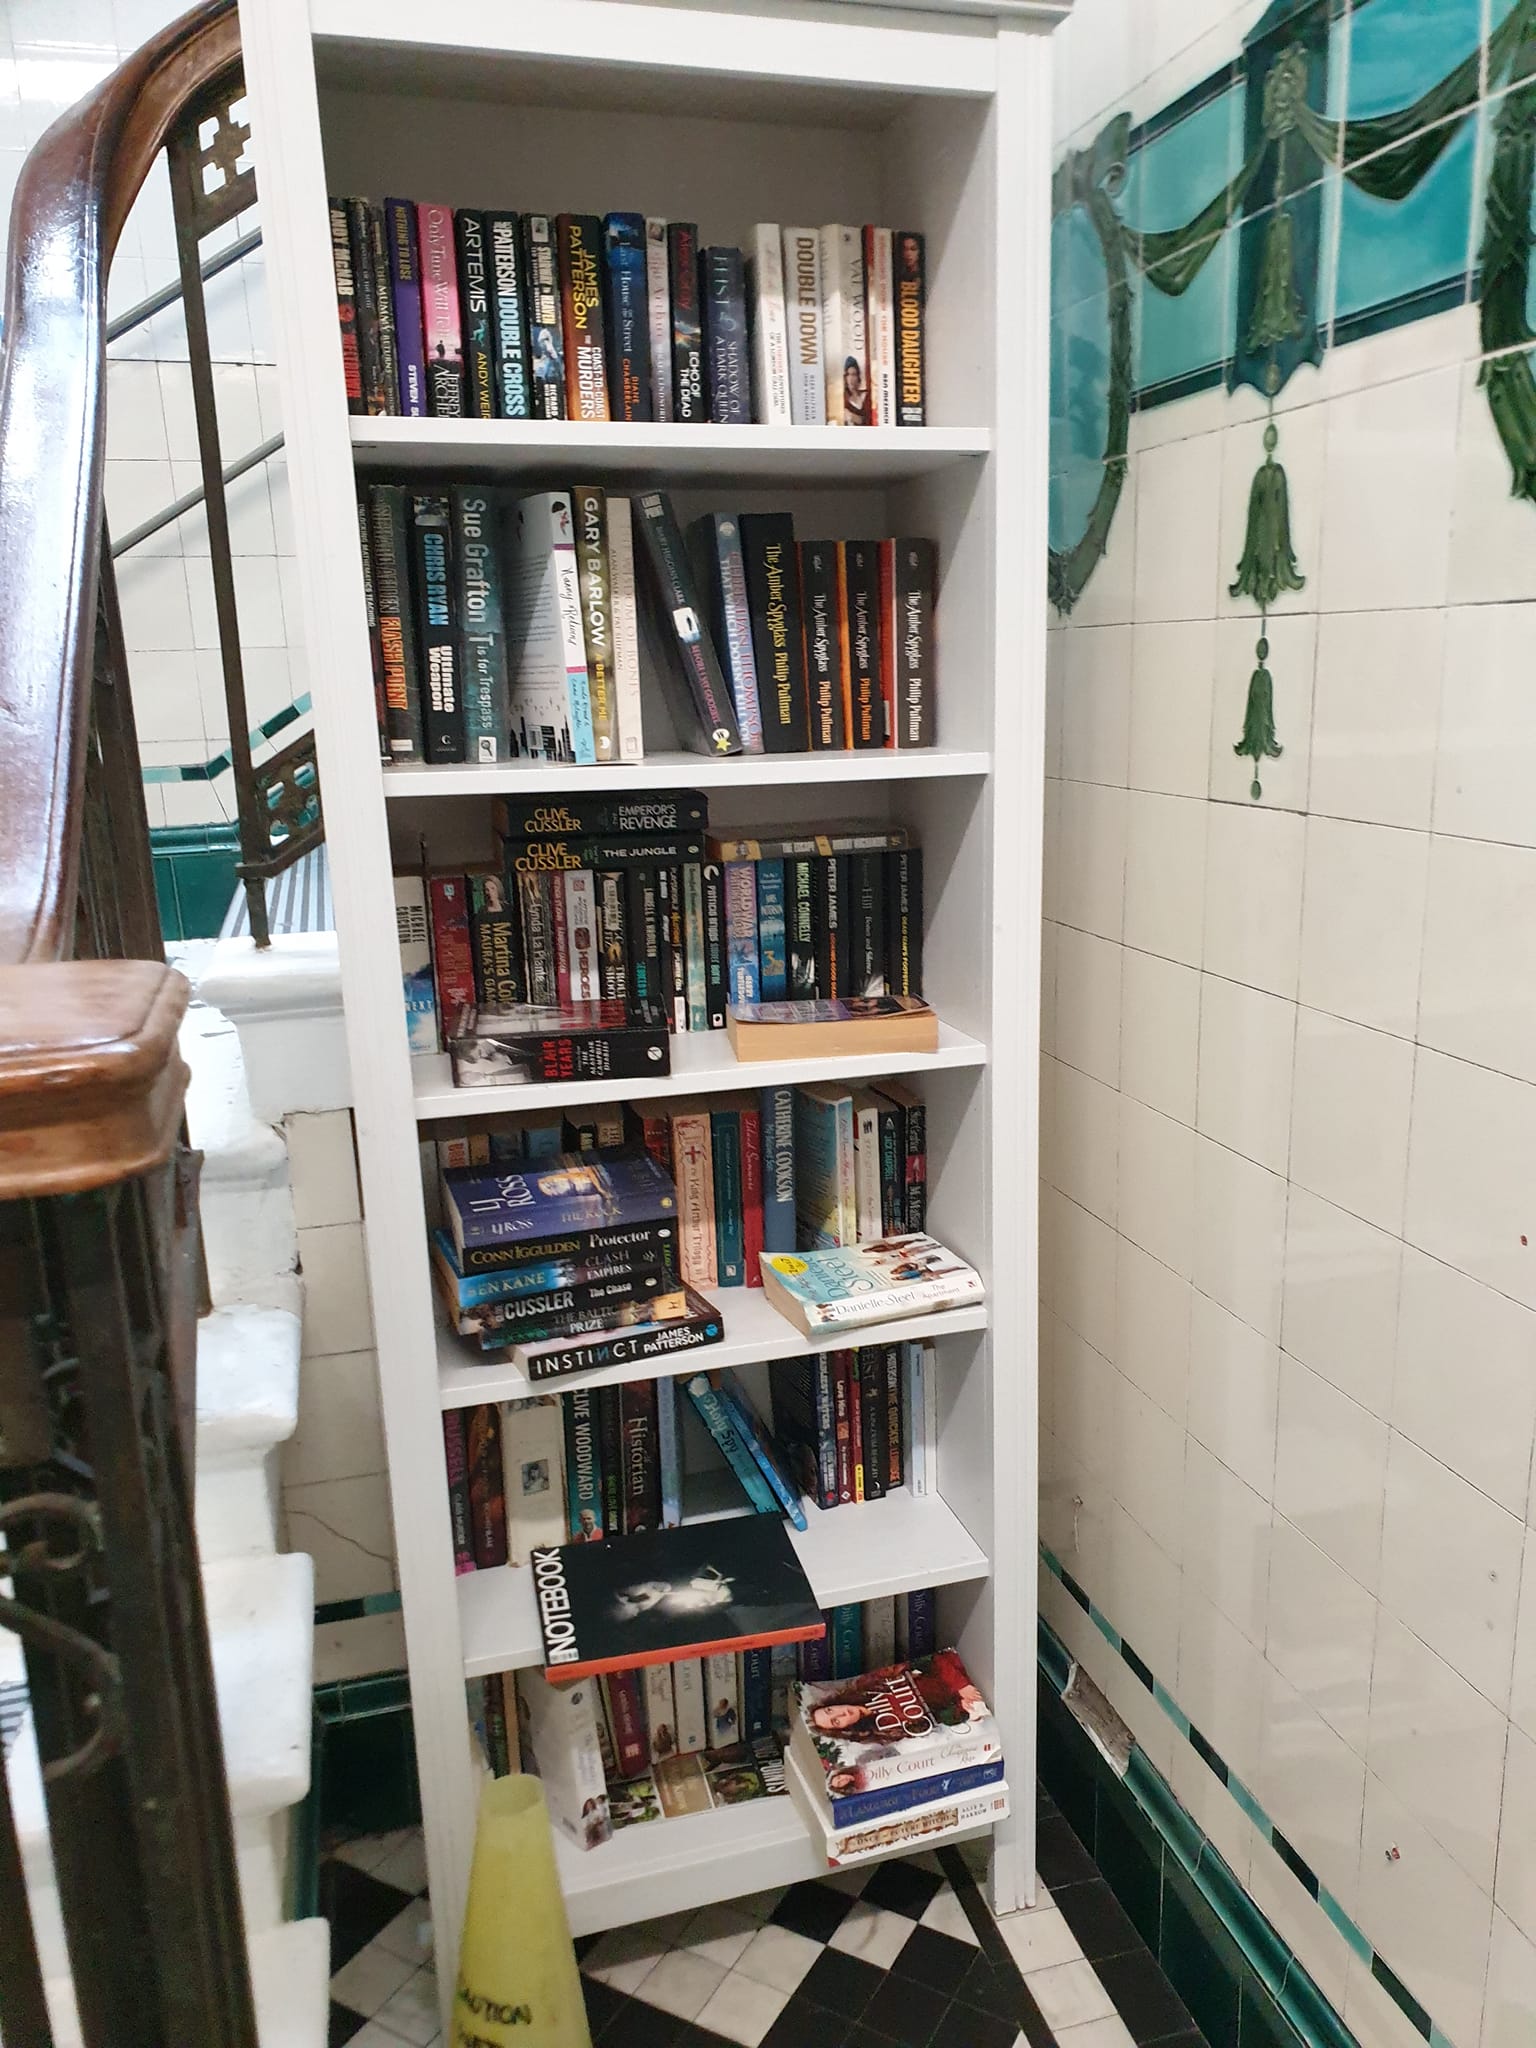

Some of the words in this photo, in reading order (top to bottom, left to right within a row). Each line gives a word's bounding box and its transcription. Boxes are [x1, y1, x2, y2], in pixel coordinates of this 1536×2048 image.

[331, 210, 351, 245] ANDY
[395, 206, 410, 246] NOTHING
[428, 209, 444, 244] Only
[399, 247, 411, 258] TO
[430, 247, 448, 278] Time
[464, 217, 487, 313] ARTEMIS
[493, 229, 517, 296] PATTERSON
[537, 246, 552, 285] STAIRWAY
[619, 243, 632, 267] Last
[334, 248, 354, 296] McNAB
[399, 259, 412, 281] LOSE
[569, 225, 587, 329] PATTERSON
[584, 249, 599, 308] JAMES
[796, 237, 816, 307] DOUBLE
[434, 280, 450, 310] Will
[620, 271, 633, 304] House
[900, 281, 921, 328] BLOOD
[377, 284, 395, 333] MUMMY
[540, 295, 556, 325] HEAVEN
[436, 316, 450, 338] Tell
[498, 298, 521, 359] DOUBLE
[622, 319, 634, 353] Street
[715, 336, 724, 345] A
[799, 311, 818, 366] DOWN
[383, 334, 393, 374] RETURNS
[477, 352, 490, 386] ANDY
[688, 351, 700, 381] ECHO
[716, 348, 728, 381] DARK
[726, 341, 740, 395] SHADOW
[902, 329, 921, 404] DAUGHTER
[408, 365, 419, 403] STEVEN
[503, 363, 526, 416] CROSS
[576, 346, 595, 419] MURDERS
[590, 346, 606, 419] COAST-TO-COAST
[622, 358, 634, 421] CHAMBERLAIN
[631, 377, 640, 404] DIANE
[680, 368, 690, 386] THE
[690, 383, 701, 398] OF
[447, 372, 461, 417] JEFFREY
[681, 389, 692, 417] DEAD
[715, 384, 730, 423] QUEEN
[730, 399, 741, 415] OF
[358, 504, 369, 544] UNLOCKING
[461, 498, 487, 537] Sue
[584, 497, 601, 555] GARY
[360, 544, 372, 593] MATHEMATICS
[423, 533, 447, 584] CHRIS
[765, 543, 782, 563] The
[465, 543, 490, 624] Grafton
[719, 559, 733, 590] THAT
[762, 560, 784, 601] Amber
[365, 594, 376, 627] TEACHING
[426, 585, 450, 626] RYAN
[586, 558, 605, 647] BARLOW
[813, 594, 827, 609] The
[855, 591, 868, 606] The
[908, 590, 921, 606] The
[723, 593, 738, 638] WHICH
[766, 601, 789, 648] Spyglass
[811, 608, 827, 637] Amber
[854, 605, 869, 634] Amber
[906, 605, 922, 635] Amber
[468, 632, 494, 647] T
[476, 646, 486, 655] is
[813, 637, 830, 672] Spyglass
[855, 634, 870, 669] Spyglass
[906, 634, 923, 669] Spyglass
[477, 658, 489, 674] for
[594, 653, 604, 662] A
[729, 639, 744, 688] DOESN'T
[772, 652, 789, 682] Philip
[427, 646, 443, 712] Weapon
[440, 645, 455, 713] Ultimate
[594, 664, 608, 704] BETTER
[816, 681, 831, 707] Philip
[858, 677, 872, 704] Philip
[905, 678, 921, 704] Philip
[476, 677, 495, 729] Trespass
[598, 706, 609, 721] ME
[735, 690, 748, 718] KILL
[776, 682, 793, 724] Pullman
[739, 720, 750, 746] YOU
[820, 707, 833, 744] Pullman
[860, 704, 873, 741] Pullman
[908, 704, 922, 741] Pullman
[524, 818, 583, 833] CUSSLER
[533, 807, 570, 821] CLIVE
[618, 804, 678, 817] EMPEROR'S
[619, 815, 678, 830] REVENGE
[515, 855, 583, 872] CUSSLER
[526, 842, 569, 858] CLIVE
[603, 849, 628, 857] THE
[629, 846, 678, 857] JUNGLE
[796, 862, 810, 899] MICHAEL
[827, 858, 837, 893] PETER
[900, 854, 908, 883] PETER
[827, 894, 838, 929] JAMES
[900, 884, 909, 913] JAMES
[410, 905, 426, 943] MICHAEL
[529, 902, 544, 933] Lynda
[797, 901, 811, 942] CONNELLY
[479, 923, 492, 975] MAURA'S
[492, 922, 514, 976] Martina
[533, 936, 544, 949] La
[533, 950, 547, 983] Plante
[578, 951, 591, 999] HEROES
[542, 1041, 559, 1078] BLAIR
[558, 1039, 574, 1078] YEARS
[744, 1118, 759, 1149] Island
[775, 1090, 794, 1149] CATHERINE
[746, 1150, 760, 1191] Summers
[776, 1151, 794, 1202] COOKSON
[494, 1174, 537, 1210] ROSS
[687, 1178, 701, 1200] King
[689, 1202, 702, 1232] Arthur
[470, 1250, 514, 1264] CONN
[514, 1239, 581, 1260] IGGULDEN
[588, 1232, 651, 1249] Protector
[691, 1233, 704, 1266] Trilogy
[584, 1250, 630, 1268] CLASH
[586, 1264, 633, 1281] EMPIRES
[818, 1256, 874, 1292] Steel
[503, 1290, 575, 1320] CUSSLER
[589, 1287, 605, 1299] The
[605, 1282, 633, 1296] Chase
[835, 1297, 884, 1316] Danielle
[884, 1290, 917, 1309] Steel
[553, 1310, 577, 1326] THE
[577, 1303, 618, 1320] BALTIC
[568, 1319, 605, 1335] PRIZE
[642, 1331, 704, 1354] PATTERSON
[655, 1326, 692, 1343] JAMES
[535, 1342, 638, 1376] INSTINCT
[572, 1387, 593, 1419] CLIVE
[836, 1380, 845, 1399] Love
[721, 1430, 739, 1454] Spy
[888, 1406, 899, 1445] QUICKIE
[574, 1422, 595, 1500] WOODWARD
[627, 1417, 648, 1496] Historian
[534, 1547, 579, 1656] NOTEBOOK
[865, 1690, 902, 1732] Dilly
[887, 1675, 934, 1738] Court
[896, 1757, 936, 1774] Court
